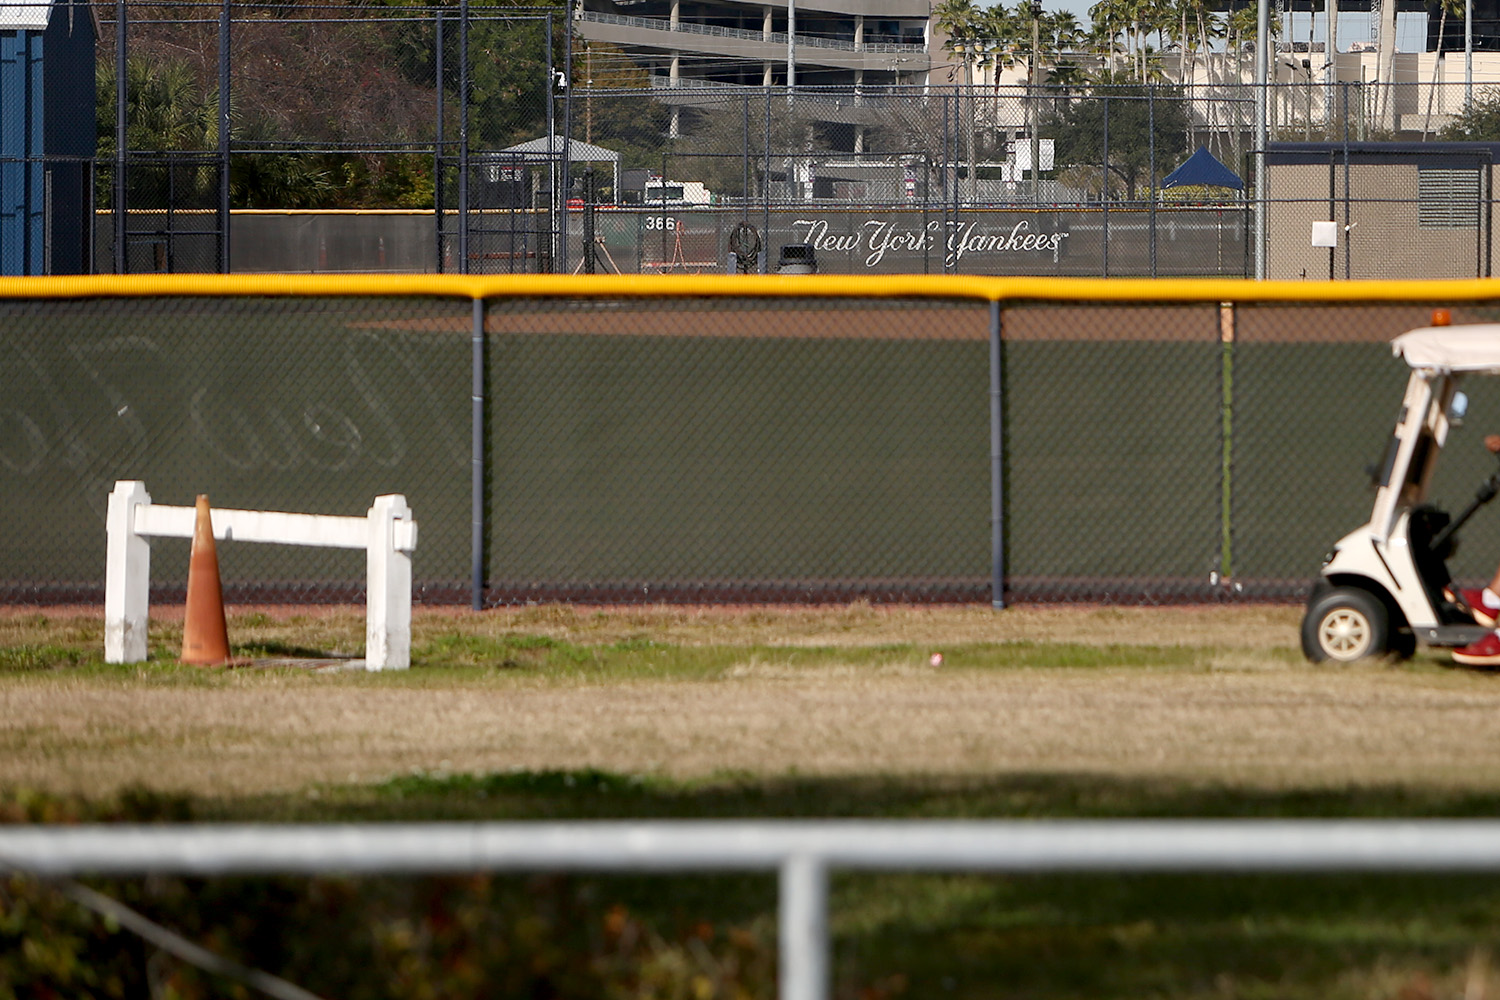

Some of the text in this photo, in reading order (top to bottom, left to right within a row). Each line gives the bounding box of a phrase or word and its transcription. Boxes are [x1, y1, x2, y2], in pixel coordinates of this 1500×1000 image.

[645, 216, 675, 231] 366
[792, 219, 860, 251] New
[864, 220, 940, 268] York
